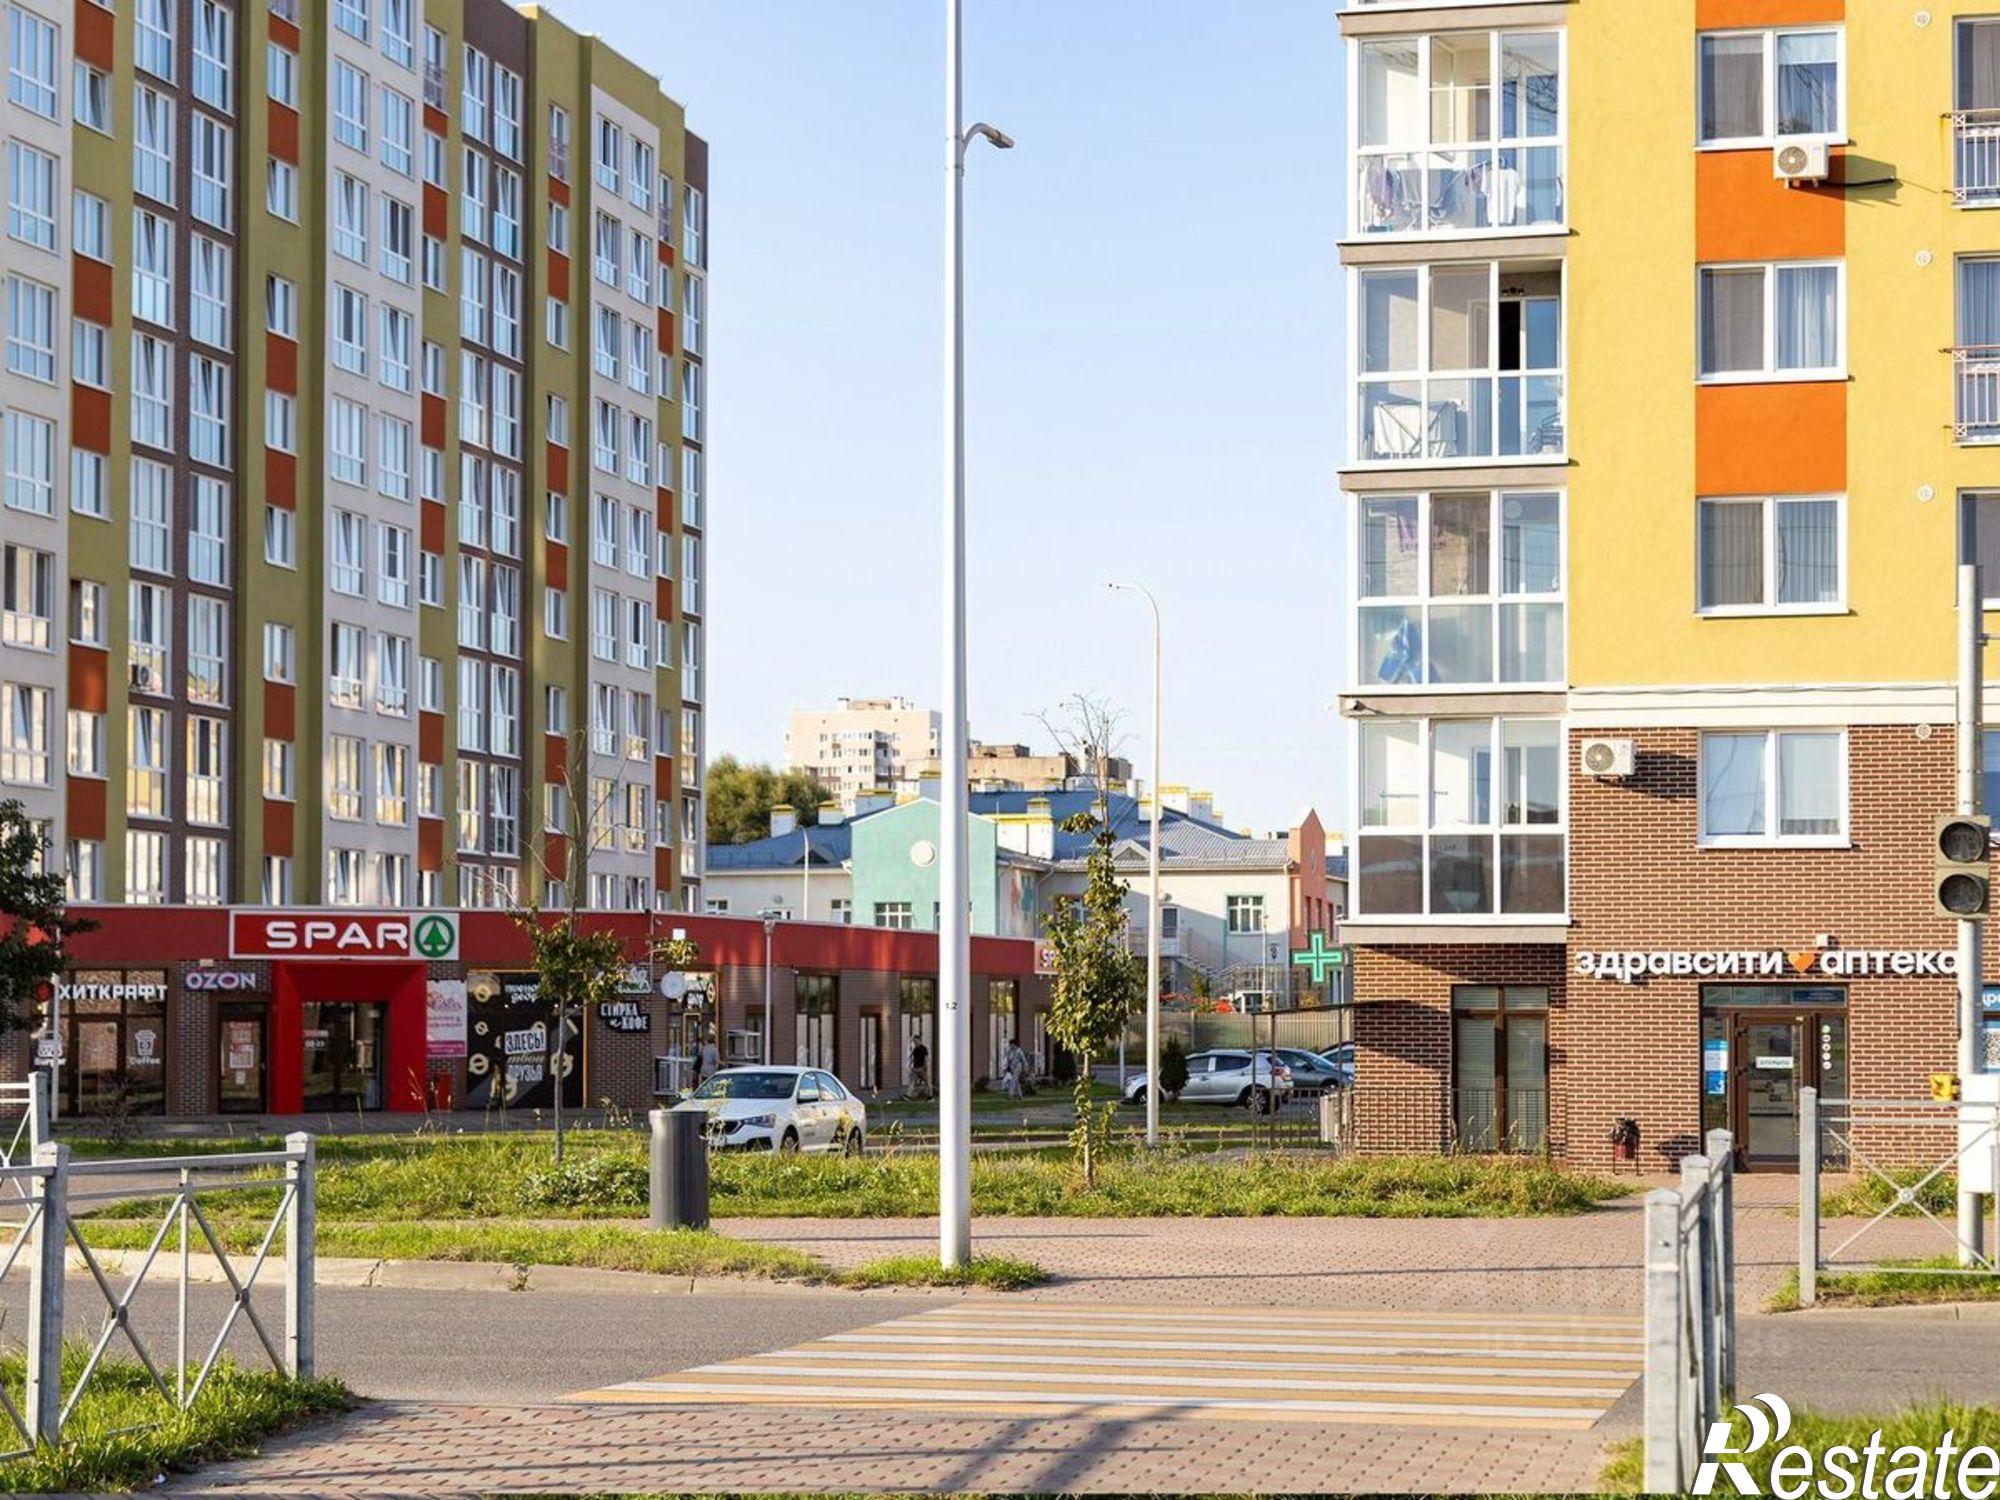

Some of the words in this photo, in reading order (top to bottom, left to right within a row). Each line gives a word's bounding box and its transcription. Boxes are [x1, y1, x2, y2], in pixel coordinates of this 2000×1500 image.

[266, 921, 408, 949] SPAR
[1574, 951, 1783, 984] здравсити
[1820, 951, 1959, 975] аптека
[185, 972, 256, 989] OZON
[59, 984, 167, 1001] ХИТКРАФТ
